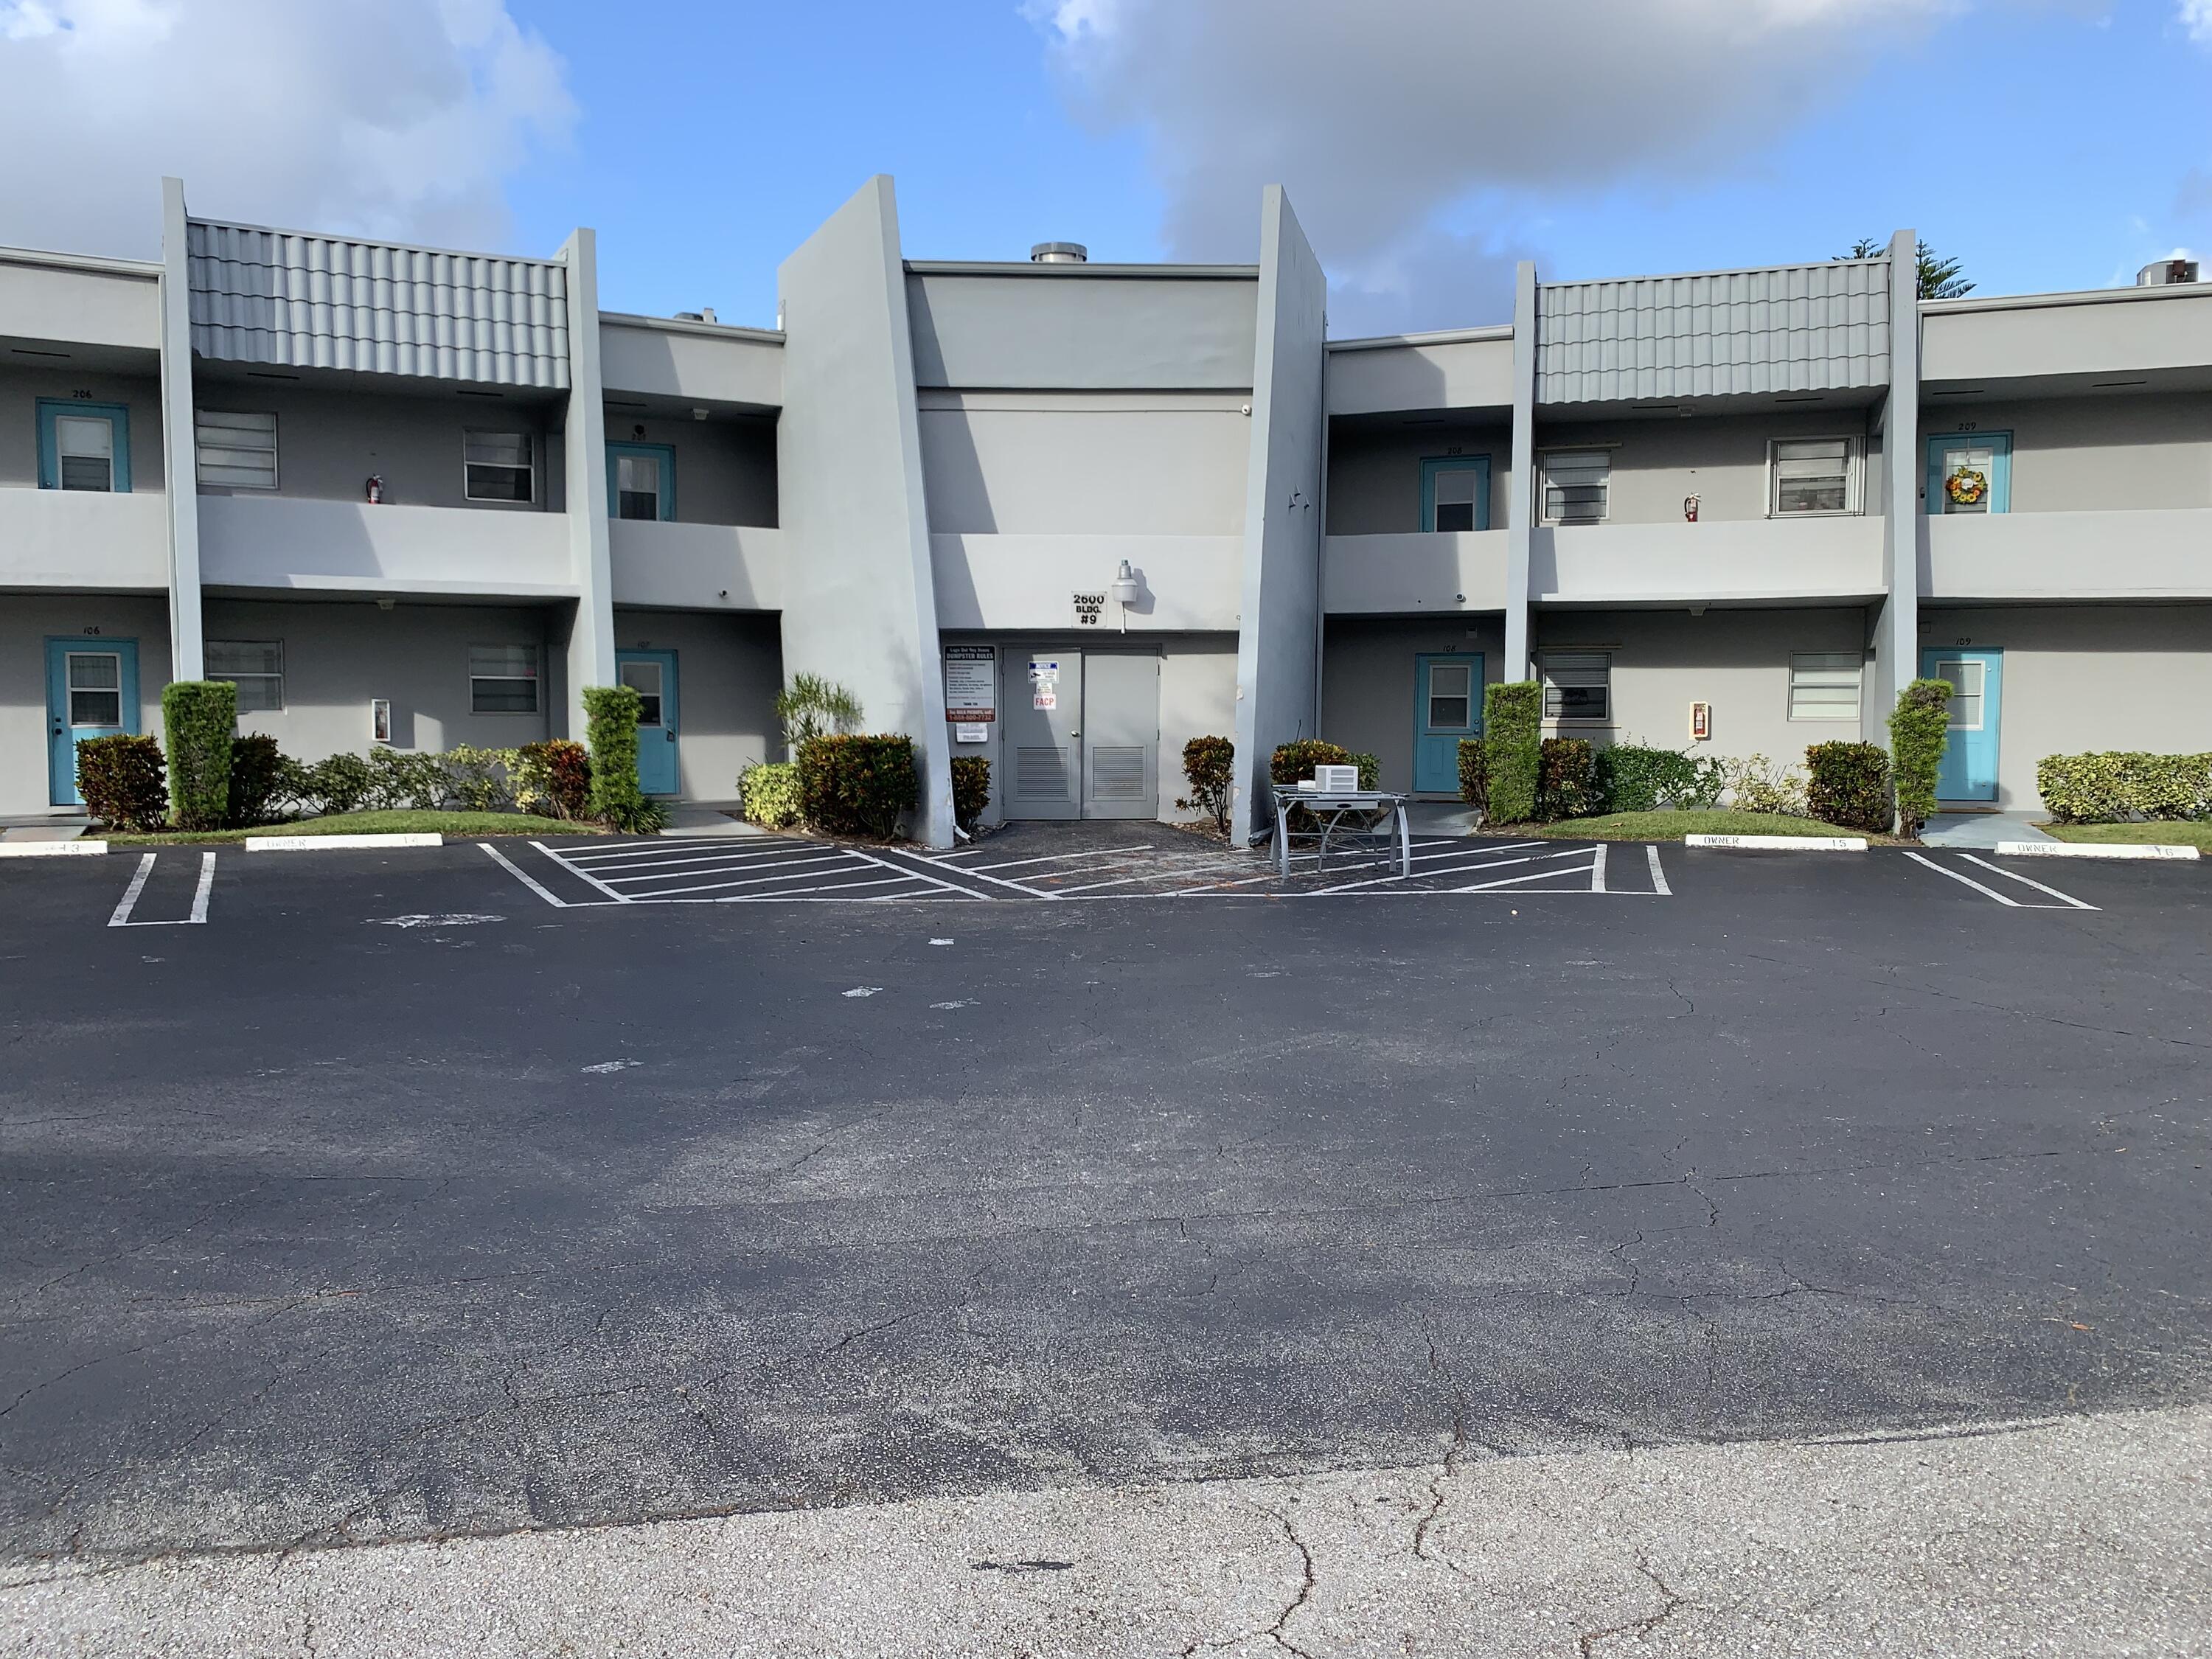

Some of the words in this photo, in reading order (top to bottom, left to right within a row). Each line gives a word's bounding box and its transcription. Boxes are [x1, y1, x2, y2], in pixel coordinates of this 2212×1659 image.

[72, 389, 93, 399] 206
[1958, 422, 1977, 431] 209
[1073, 594, 1105, 604] 2600
[1080, 614, 1096, 625] #9
[83, 626, 100, 635] 106
[1955, 638, 1972, 646] 109
[1035, 698, 1054, 706] FACP
[1704, 836, 1739, 845] OWNER
[1832, 839, 1847, 848] 15
[2017, 844, 2058, 854] OWNER
